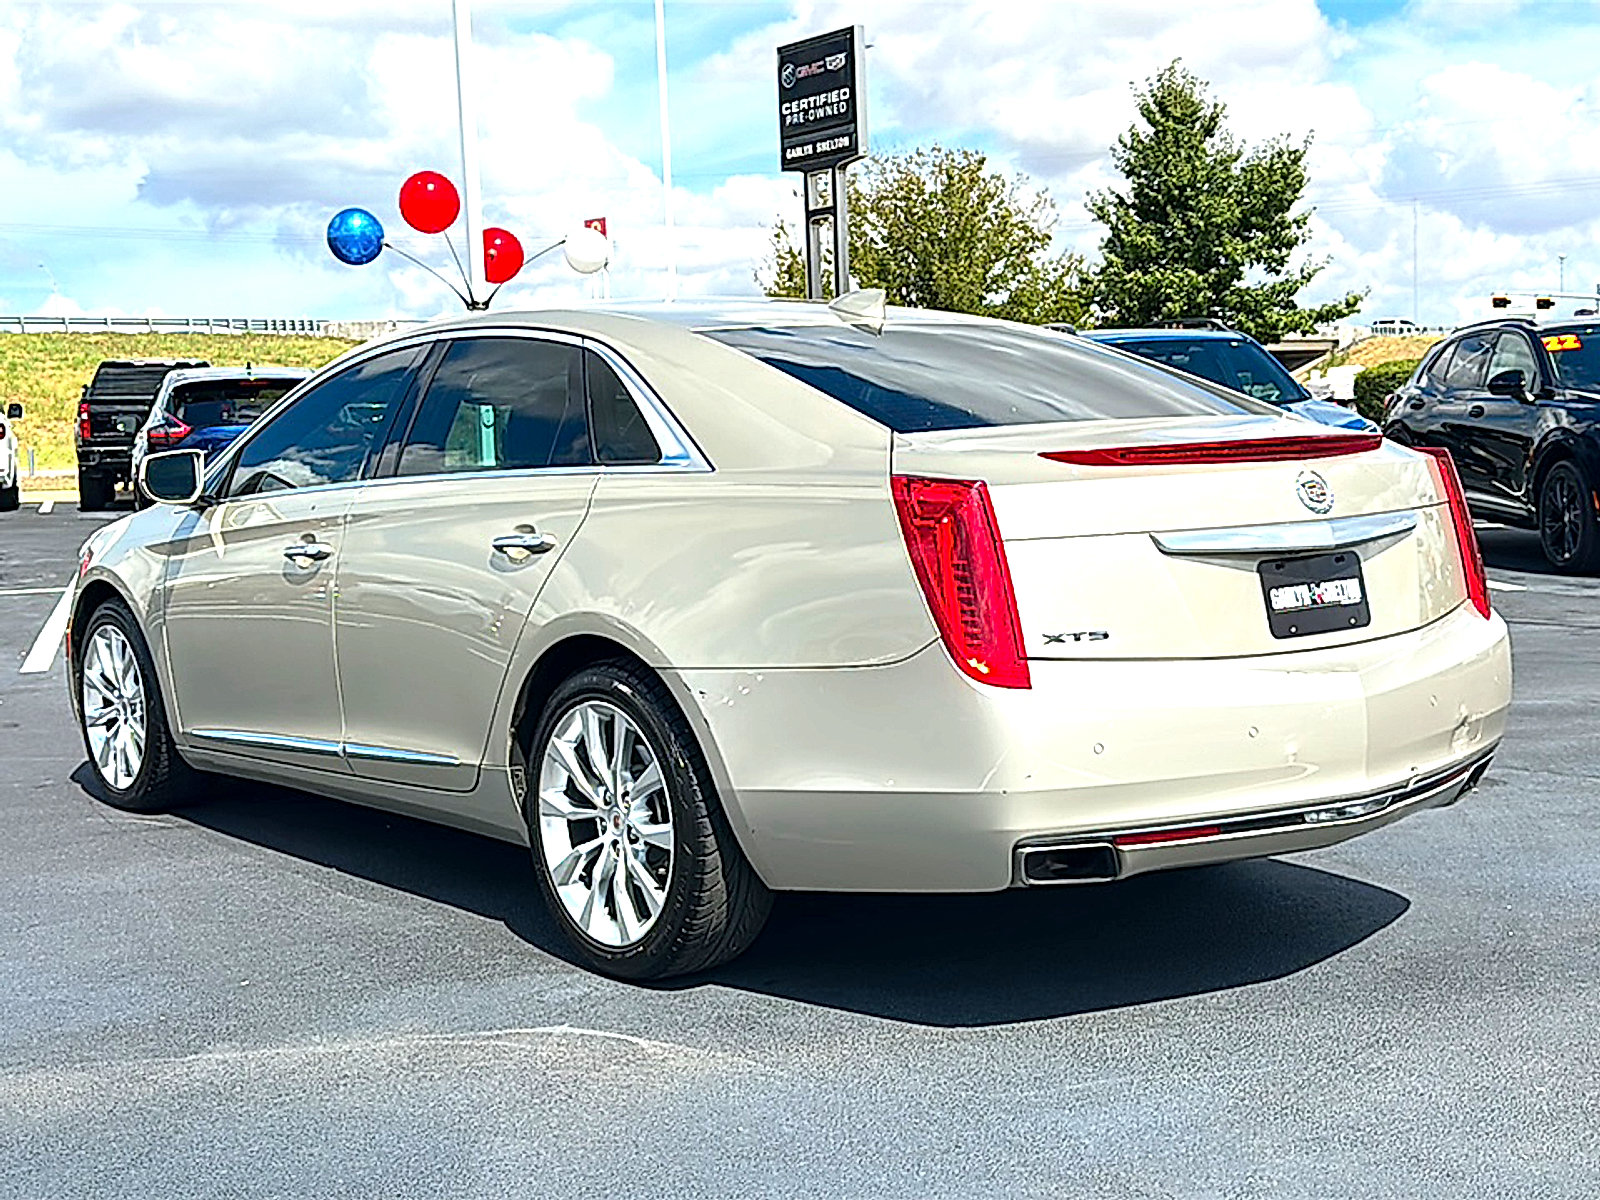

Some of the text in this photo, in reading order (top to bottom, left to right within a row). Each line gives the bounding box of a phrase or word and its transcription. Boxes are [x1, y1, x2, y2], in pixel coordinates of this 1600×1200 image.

[796, 60, 825, 79] GMC
[781, 88, 850, 115] CERTIFIED
[785, 101, 847, 127] PRE-OWNED
[1042, 631, 1109, 645] XTS
